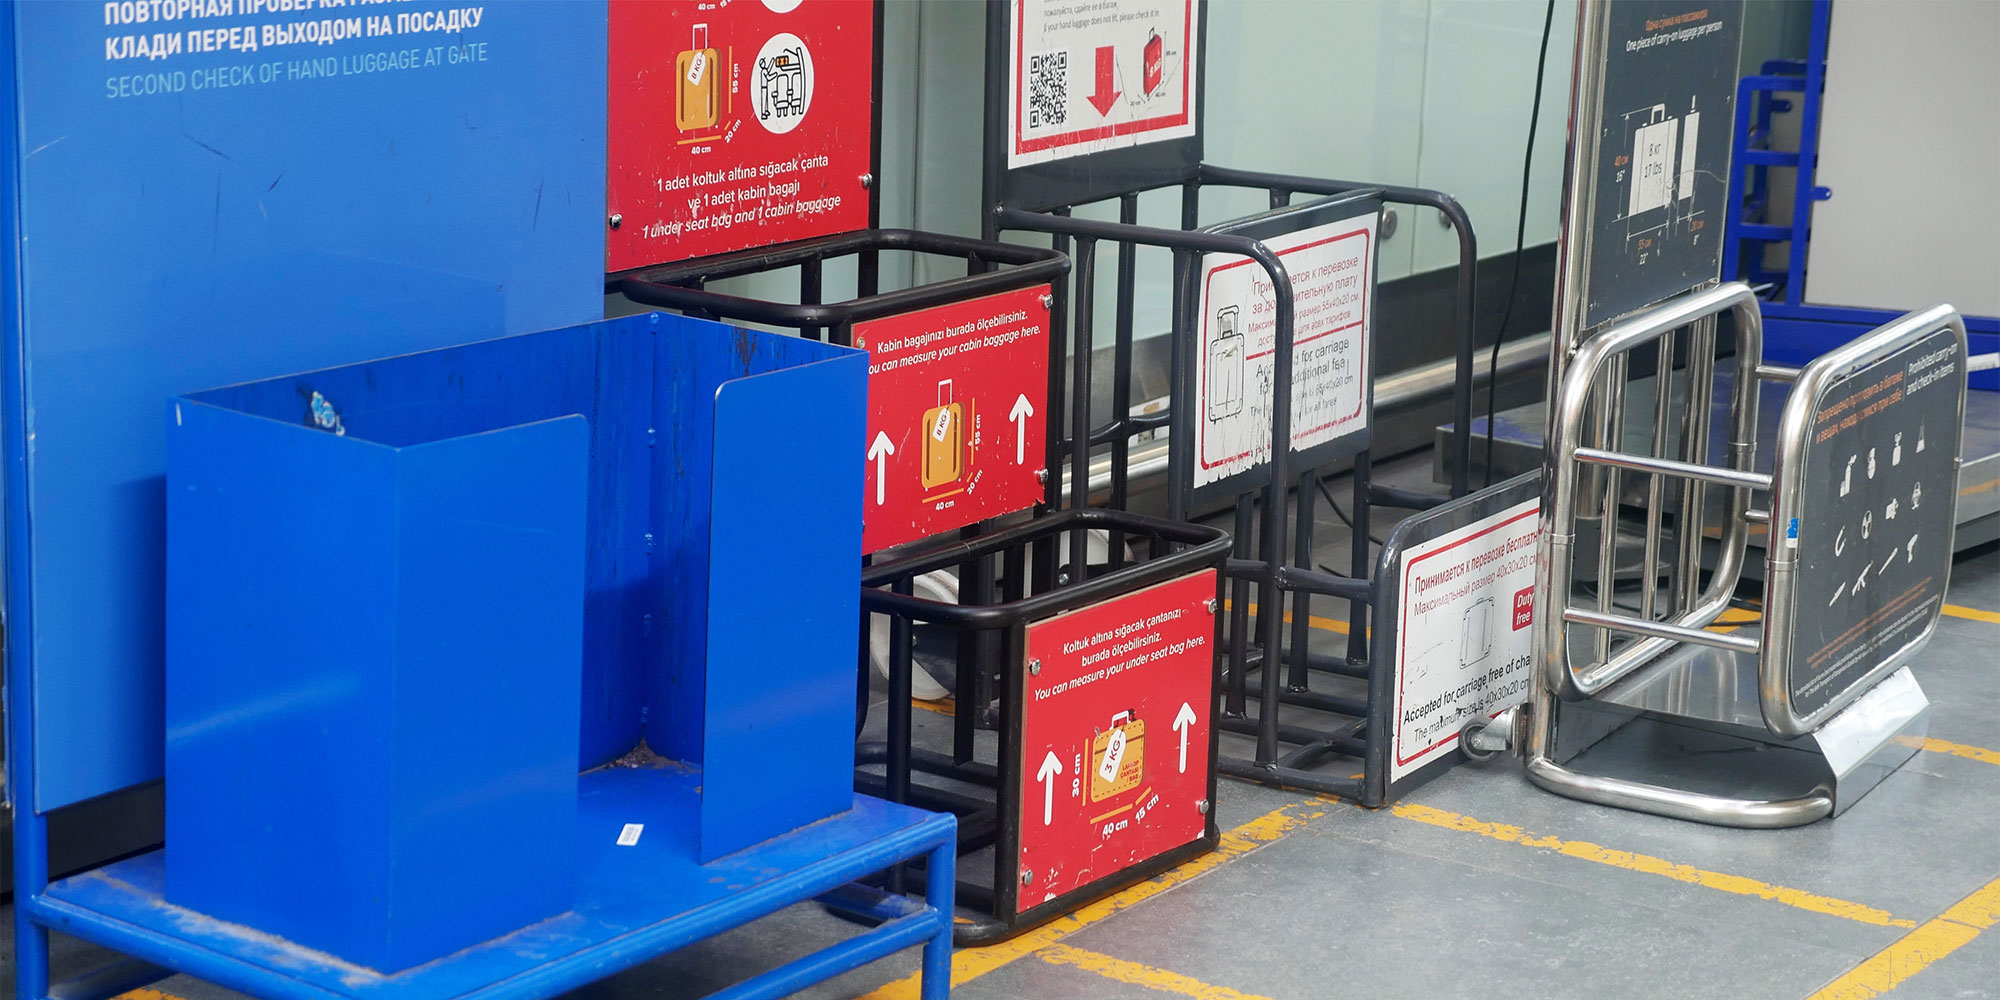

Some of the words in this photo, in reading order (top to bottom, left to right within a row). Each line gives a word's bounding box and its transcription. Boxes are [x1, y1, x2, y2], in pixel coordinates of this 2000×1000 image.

[105, 0, 233, 25] ПОВТОРНАЯ
[1060, 20, 1071, 30] hand
[1072, 18, 1090, 29] luggage
[1091, 16, 1102, 26] does
[1103, 15, 1111, 24] not
[1120, 12, 1135, 23] please
[1136, 9, 1149, 19] check
[105, 32, 182, 61] КЛАДИ
[187, 26, 258, 53] ПЕРЕД
[262, 17, 362, 47] ВЫХОДОМ
[366, 15, 393, 37] НА
[397, 7, 484, 34] ПОСАДКУ
[1626, 39, 1637, 52] One
[1637, 36, 1650, 52] piece
[1657, 31, 1678, 46] carry-on
[1679, 27, 1697, 42] luggage
[1697, 25, 1705, 38] per
[1705, 20, 1722, 36] person
[106, 71, 186, 99] SECOND
[191, 66, 255, 91] CHECK
[259, 62, 283, 84] OF
[288, 57, 338, 81] HAND
[343, 49, 421, 76] LUGGAGE
[424, 47, 445, 67] AT
[448, 42, 489, 65] GATE
[691, 146, 701, 155] 40
[702, 145, 712, 153] cm
[1649, 143, 1653, 157] 8
[657, 178, 663, 192] 1
[665, 175, 690, 191] adet
[692, 168, 725, 187] koltuk
[728, 163, 757, 182] altına
[759, 157, 799, 178] sığacak
[800, 155, 829, 173] çanta
[1645, 163, 1652, 178] 17
[1653, 161, 1663, 176] lbs
[688, 198, 701, 210] ve
[703, 193, 709, 207] 1
[711, 189, 735, 205] adet
[737, 184, 767, 202] kabin
[769, 179, 801, 198] bagajı
[642, 225, 649, 239] 1
[650, 221, 682, 238] under
[685, 216, 709, 232] seat
[711, 213, 733, 229] bag
[734, 207, 756, 224] and
[758, 205, 763, 219] 1
[765, 202, 793, 218] cabin
[796, 195, 842, 214] baggage
[1312, 270, 1317, 279] к
[1318, 256, 1359, 277] перевозке
[1252, 304, 1263, 315] за
[1335, 274, 1359, 290] плату
[1299, 305, 1321, 319] размер
[877, 338, 902, 354] Kabin
[904, 331, 945, 350] bagajınızı
[946, 321, 975, 338] burada
[977, 309, 1028, 332] ölçebilirsiniz.
[868, 362, 880, 375] ou
[881, 358, 898, 372] can
[899, 347, 937, 368] measure
[938, 345, 957, 361] your
[959, 337, 982, 353] cabin
[983, 331, 1020, 348] baggage
[1021, 323, 1041, 338] here.
[1302, 349, 1314, 363] for
[1908, 350, 1936, 376] Prohibited
[1936, 342, 1958, 363] carry-on
[1291, 360, 1330, 385] dditional
[1906, 377, 1918, 395] and
[1917, 369, 1939, 390] check-in
[1940, 361, 1955, 378] items
[939, 414, 947, 429] KG
[974, 469, 983, 483] cm
[936, 502, 944, 511] 40
[945, 500, 955, 509] cm
[1415, 563, 1465, 596] Принимается
[1466, 561, 1470, 574] к
[1471, 545, 1505, 570] перевозке
[1506, 530, 1538, 557] бесплатн
[1413, 581, 1470, 617] Максимальный
[1471, 572, 1496, 594] размер
[1517, 591, 1534, 609] Duty
[1063, 639, 1090, 655] Koltuk
[1091, 630, 1113, 646] altına
[1114, 619, 1145, 639] sığacak
[1146, 608, 1182, 630] çantanızı
[1516, 611, 1531, 626] free
[1081, 650, 1110, 667] burada
[1111, 632, 1162, 657] ölçebilirsiniz.
[1034, 687, 1051, 701] You
[1052, 682, 1068, 696] can
[1069, 669, 1105, 690] measure
[1105, 663, 1124, 680] your
[1125, 653, 1149, 670] under
[1150, 647, 1168, 662] seat
[1168, 641, 1185, 657] bag
[1185, 635, 1205, 650] here.
[1403, 694, 1442, 725] Accepted
[1443, 689, 1455, 706] for
[1455, 675, 1487, 699] carriage
[1488, 666, 1504, 683] free
[1505, 658, 1514, 675] of
[1414, 726, 1428, 741] The
[1074, 753, 1081, 775] cm
[1105, 763, 1112, 773] 3
[1109, 740, 1121, 761] KG
[1072, 778, 1080, 798] 30
[1135, 807, 1145, 821] 15
[1147, 794, 1160, 810] cm
[1102, 823, 1114, 837] 40
[1115, 819, 1128, 832] cm
